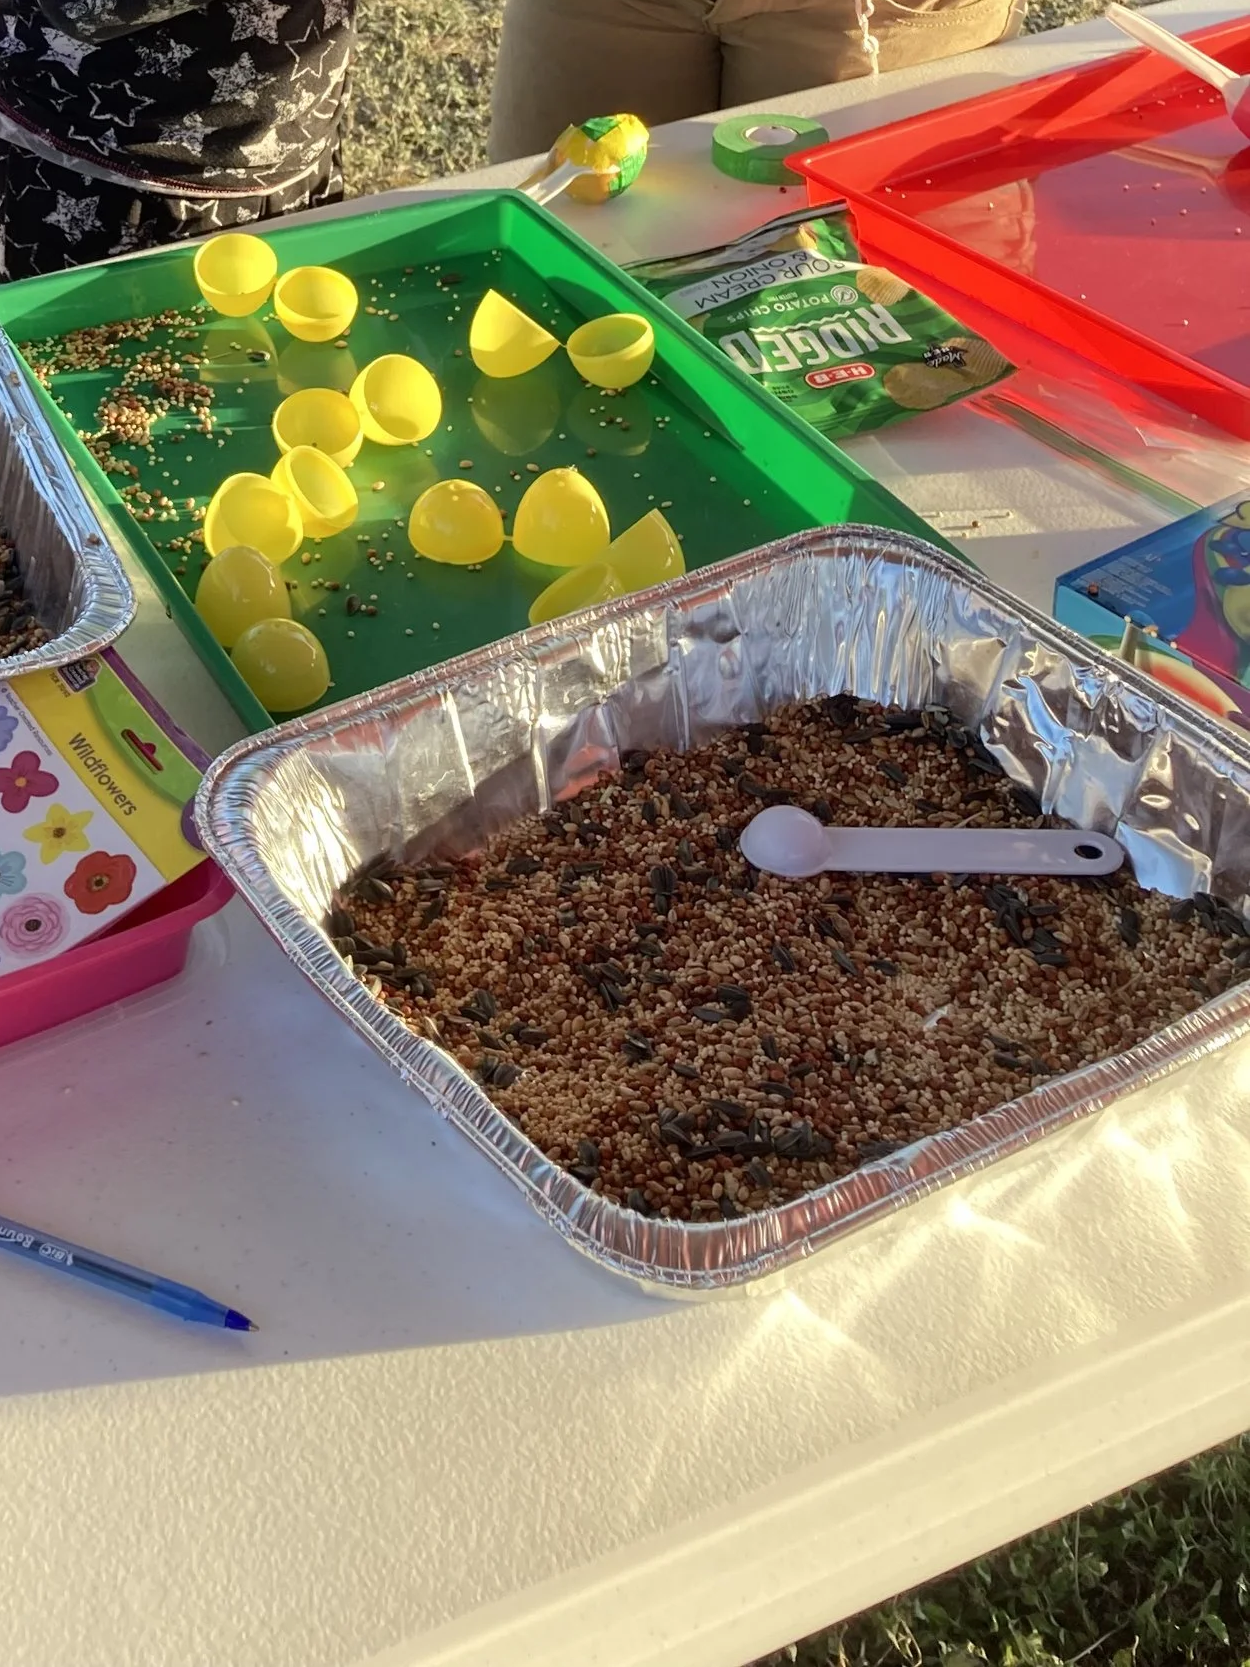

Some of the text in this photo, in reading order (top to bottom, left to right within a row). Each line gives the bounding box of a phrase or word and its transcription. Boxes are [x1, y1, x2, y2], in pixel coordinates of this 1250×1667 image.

[694, 272, 777, 310] CREAM
[711, 257, 787, 289] ONION
[726, 293, 831, 324] POTATO CHIPS
[718, 303, 913, 375] RIDGED
[68, 731, 138, 817] Wildflowers
